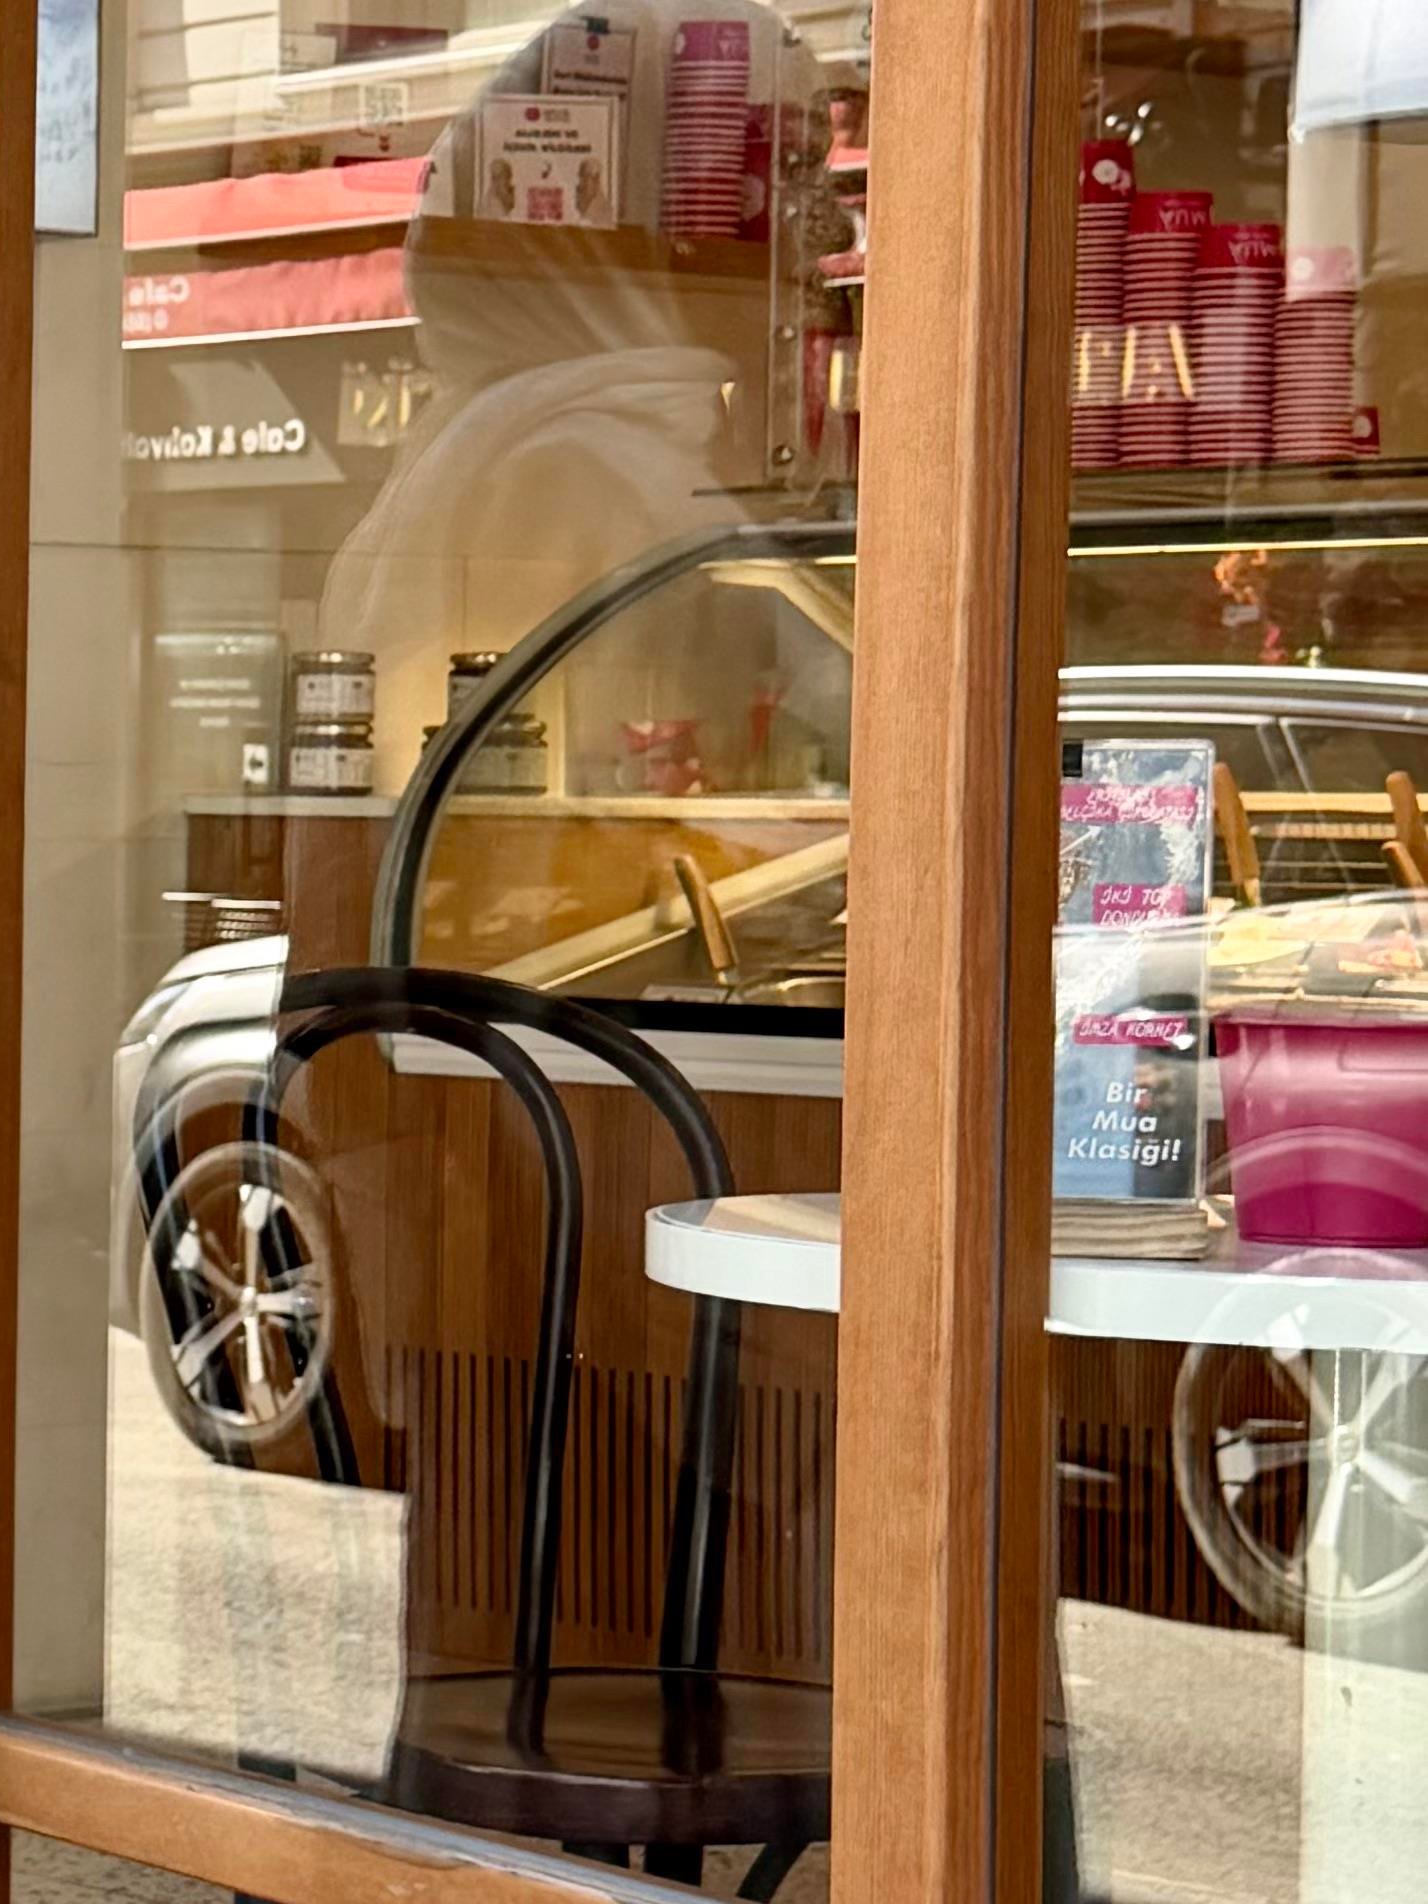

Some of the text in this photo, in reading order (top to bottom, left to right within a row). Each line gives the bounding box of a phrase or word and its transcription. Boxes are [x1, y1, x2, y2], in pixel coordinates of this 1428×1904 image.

[1105, 1081, 1149, 1104] Bir
[1092, 1109, 1158, 1133] Mua
[1067, 1136, 1182, 1167] Klasiği!
